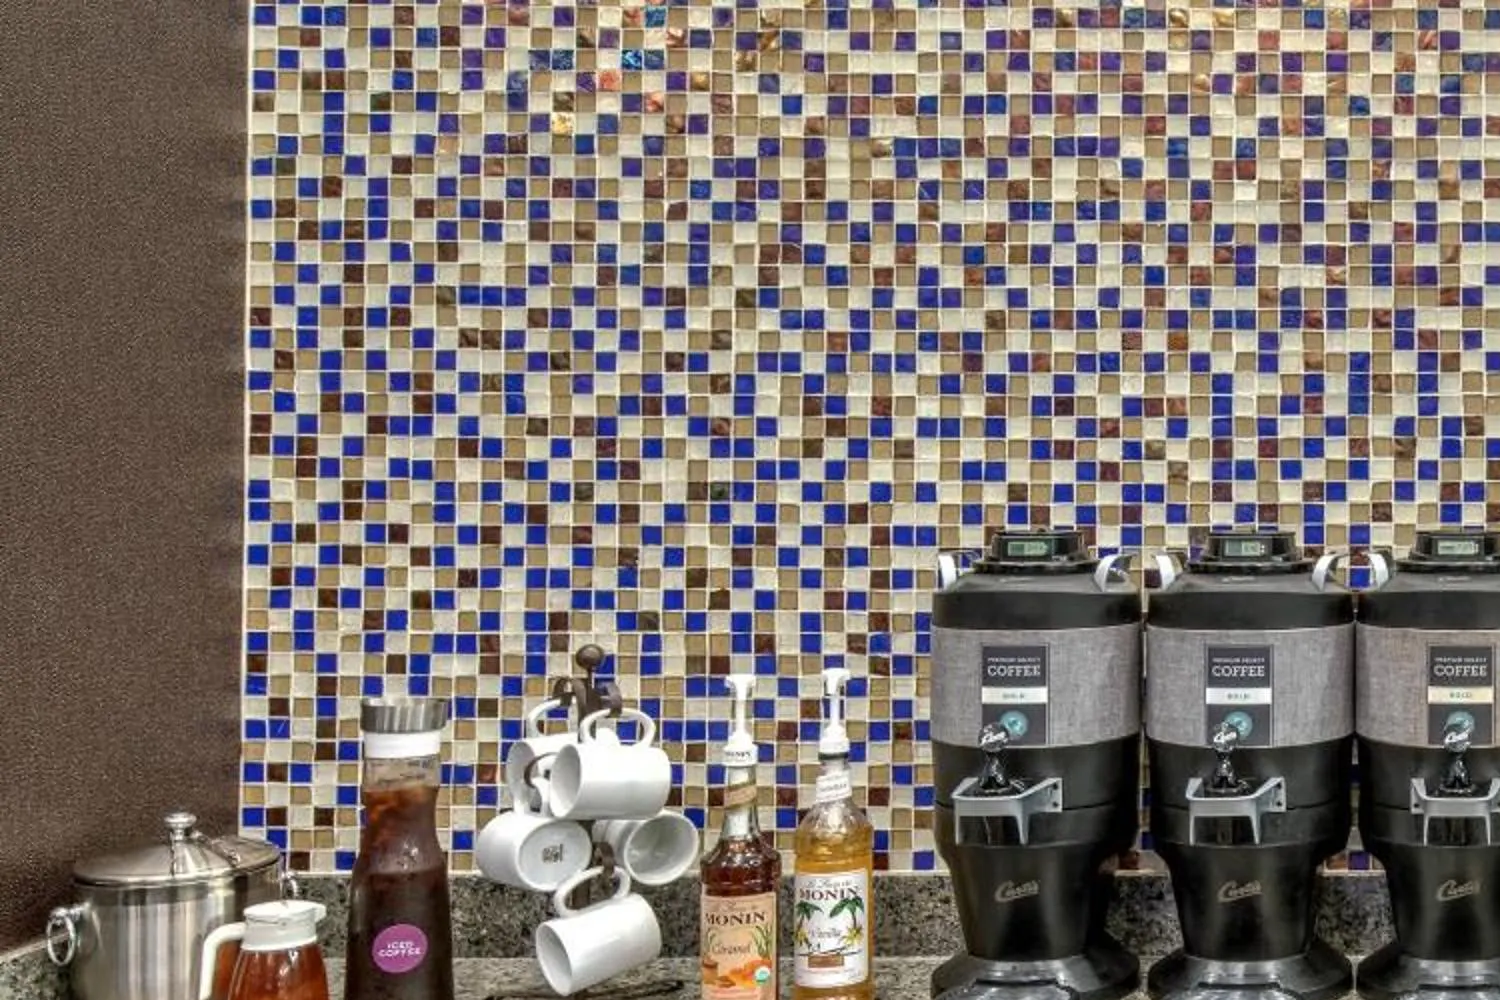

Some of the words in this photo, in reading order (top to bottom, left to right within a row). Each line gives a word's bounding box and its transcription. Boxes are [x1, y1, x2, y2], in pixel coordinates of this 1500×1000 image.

[987, 664, 1041, 677] COFFEE
[1211, 664, 1266, 677] COFFEE
[1433, 664, 1488, 677] COFFEE
[800, 884, 859, 901] MONIN
[705, 911, 766, 927] MONIN
[378, 947, 421, 958] COFFEE
